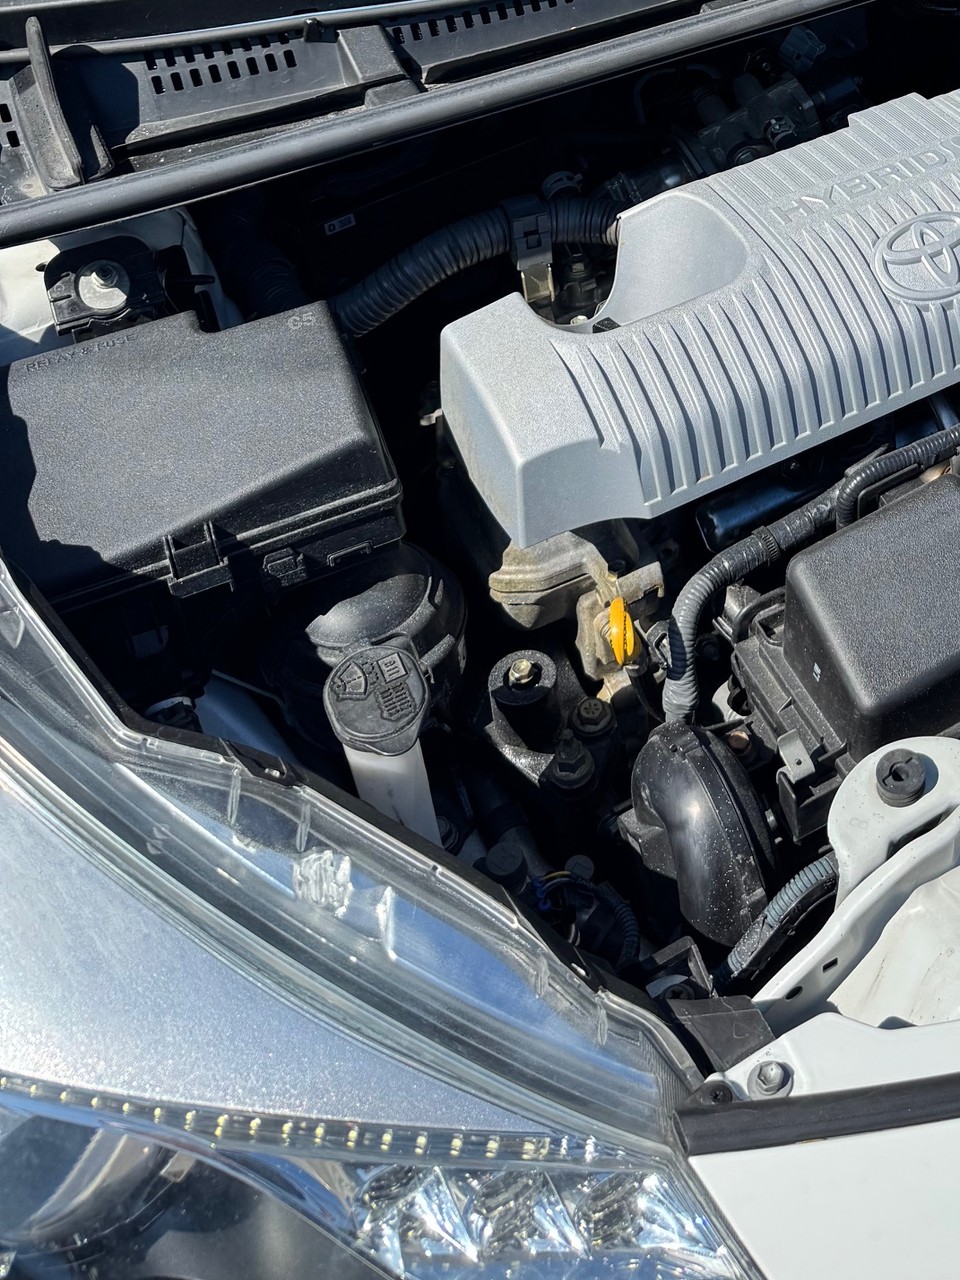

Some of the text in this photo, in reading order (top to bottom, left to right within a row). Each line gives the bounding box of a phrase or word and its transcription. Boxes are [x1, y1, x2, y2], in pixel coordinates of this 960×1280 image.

[770, 148, 948, 225] HYBRID
[26, 351, 76, 372] RELAY
[96, 333, 139, 352] FUSE
